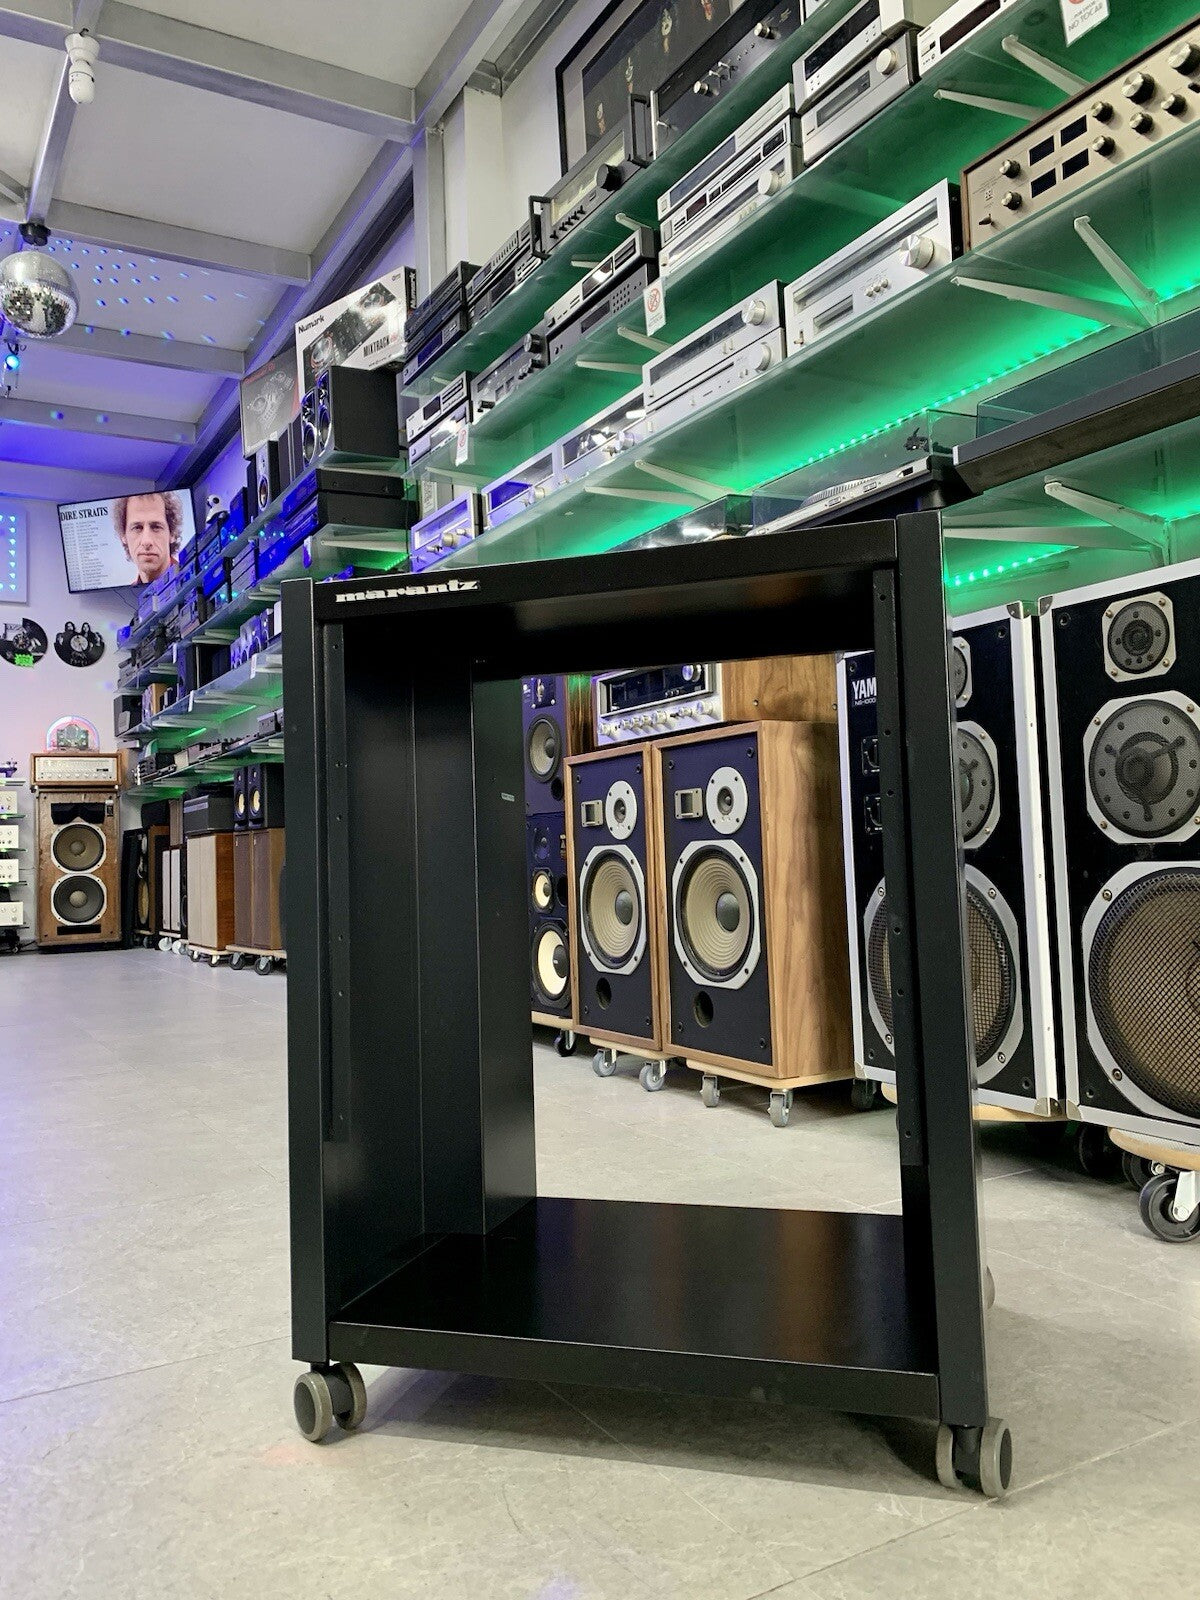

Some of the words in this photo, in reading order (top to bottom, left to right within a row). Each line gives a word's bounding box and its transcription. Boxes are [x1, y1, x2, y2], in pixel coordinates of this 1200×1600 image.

[1068, 20, 1079, 31] NO
[298, 315, 325, 334] Numark
[60, 509, 78, 522] DIRE
[78, 506, 109, 519] STRAITS
[335, 579, 479, 603] marantz
